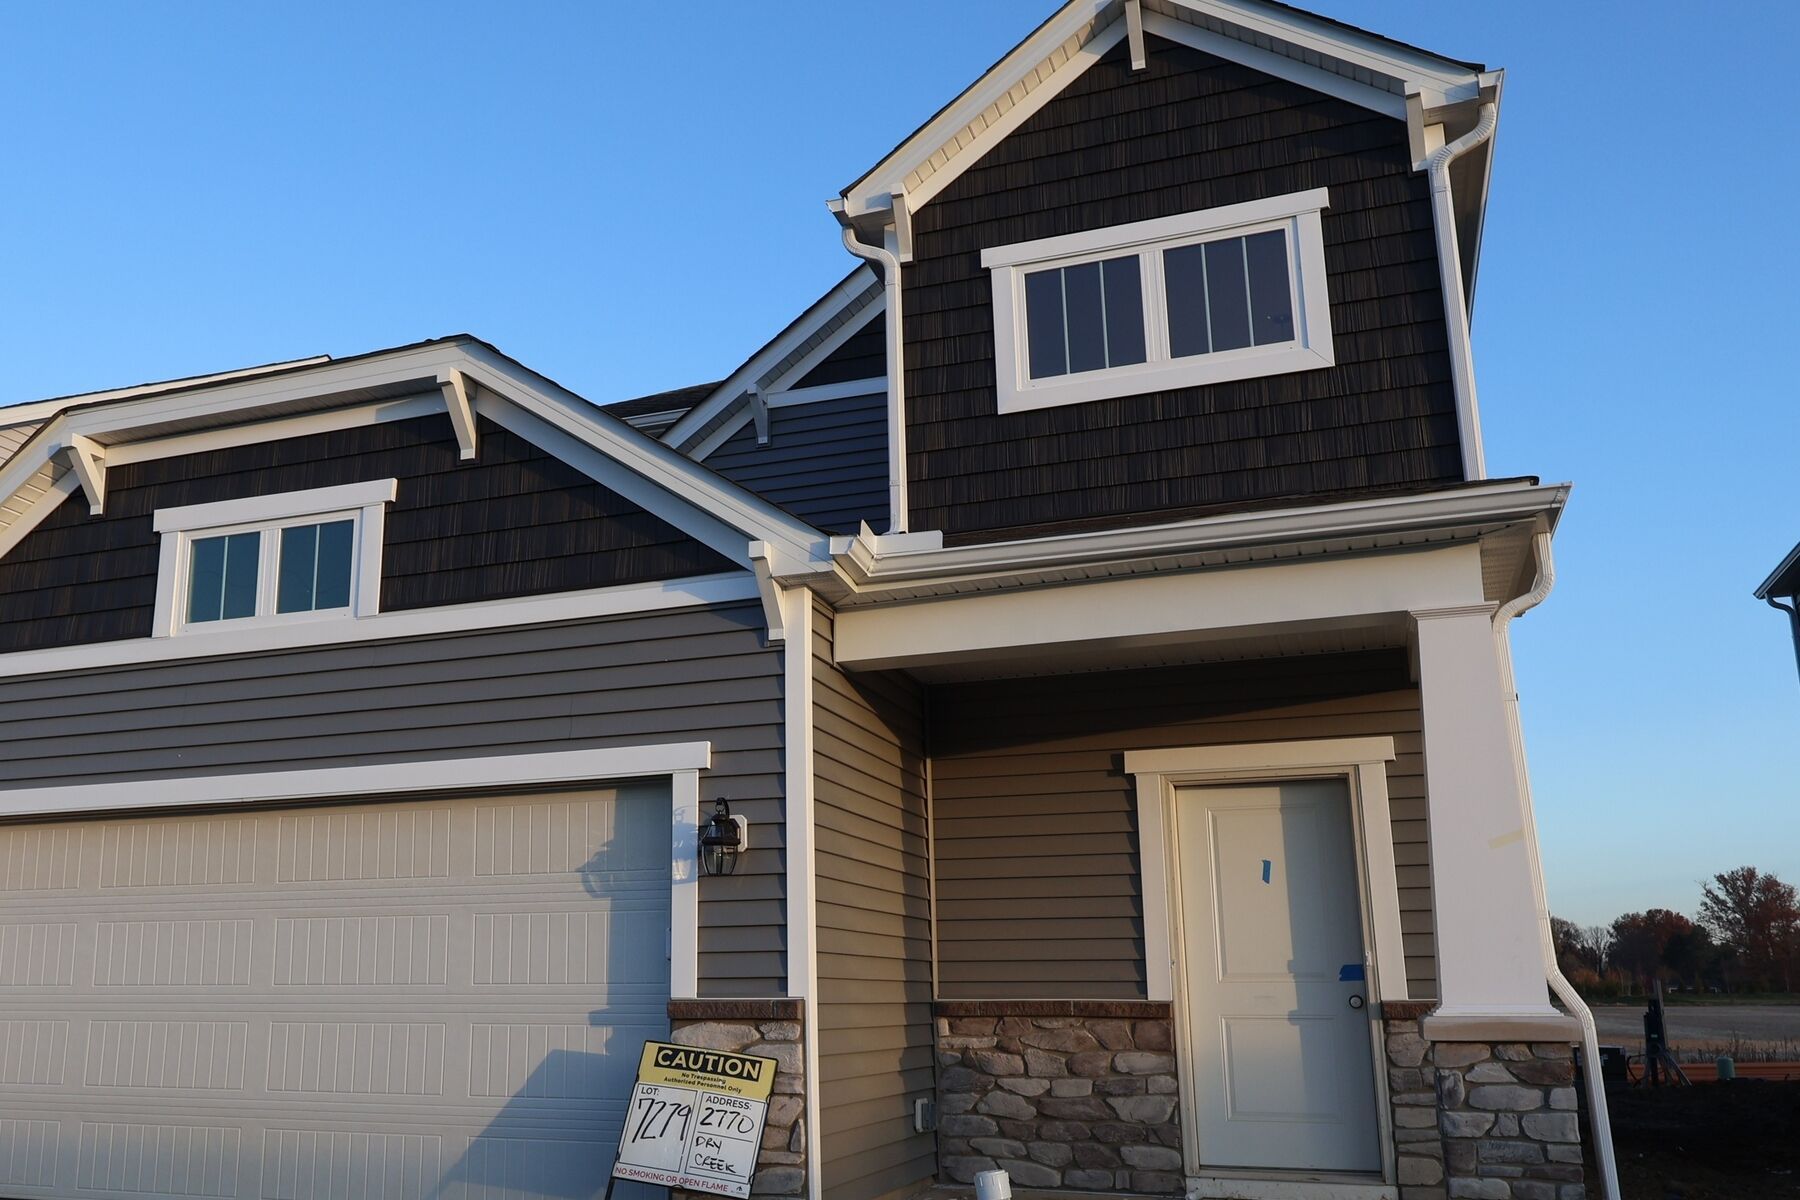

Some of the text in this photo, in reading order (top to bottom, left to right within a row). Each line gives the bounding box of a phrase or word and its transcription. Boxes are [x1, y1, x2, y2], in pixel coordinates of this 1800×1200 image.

[657, 1049, 760, 1080] CAUTION
[690, 1073, 727, 1085] Trespassing
[697, 1081, 727, 1090] Personnel
[728, 1085, 742, 1093] Only
[641, 1086, 660, 1096] LOT:
[705, 1095, 752, 1111] ADDRESS:
[632, 1098, 692, 1143] 7279
[700, 1107, 755, 1133] 2770
[695, 1136, 722, 1154] DRY
[694, 1154, 737, 1173] CREEK
[615, 1167, 729, 1192] NO SMOKING OR OPEN FLAME
